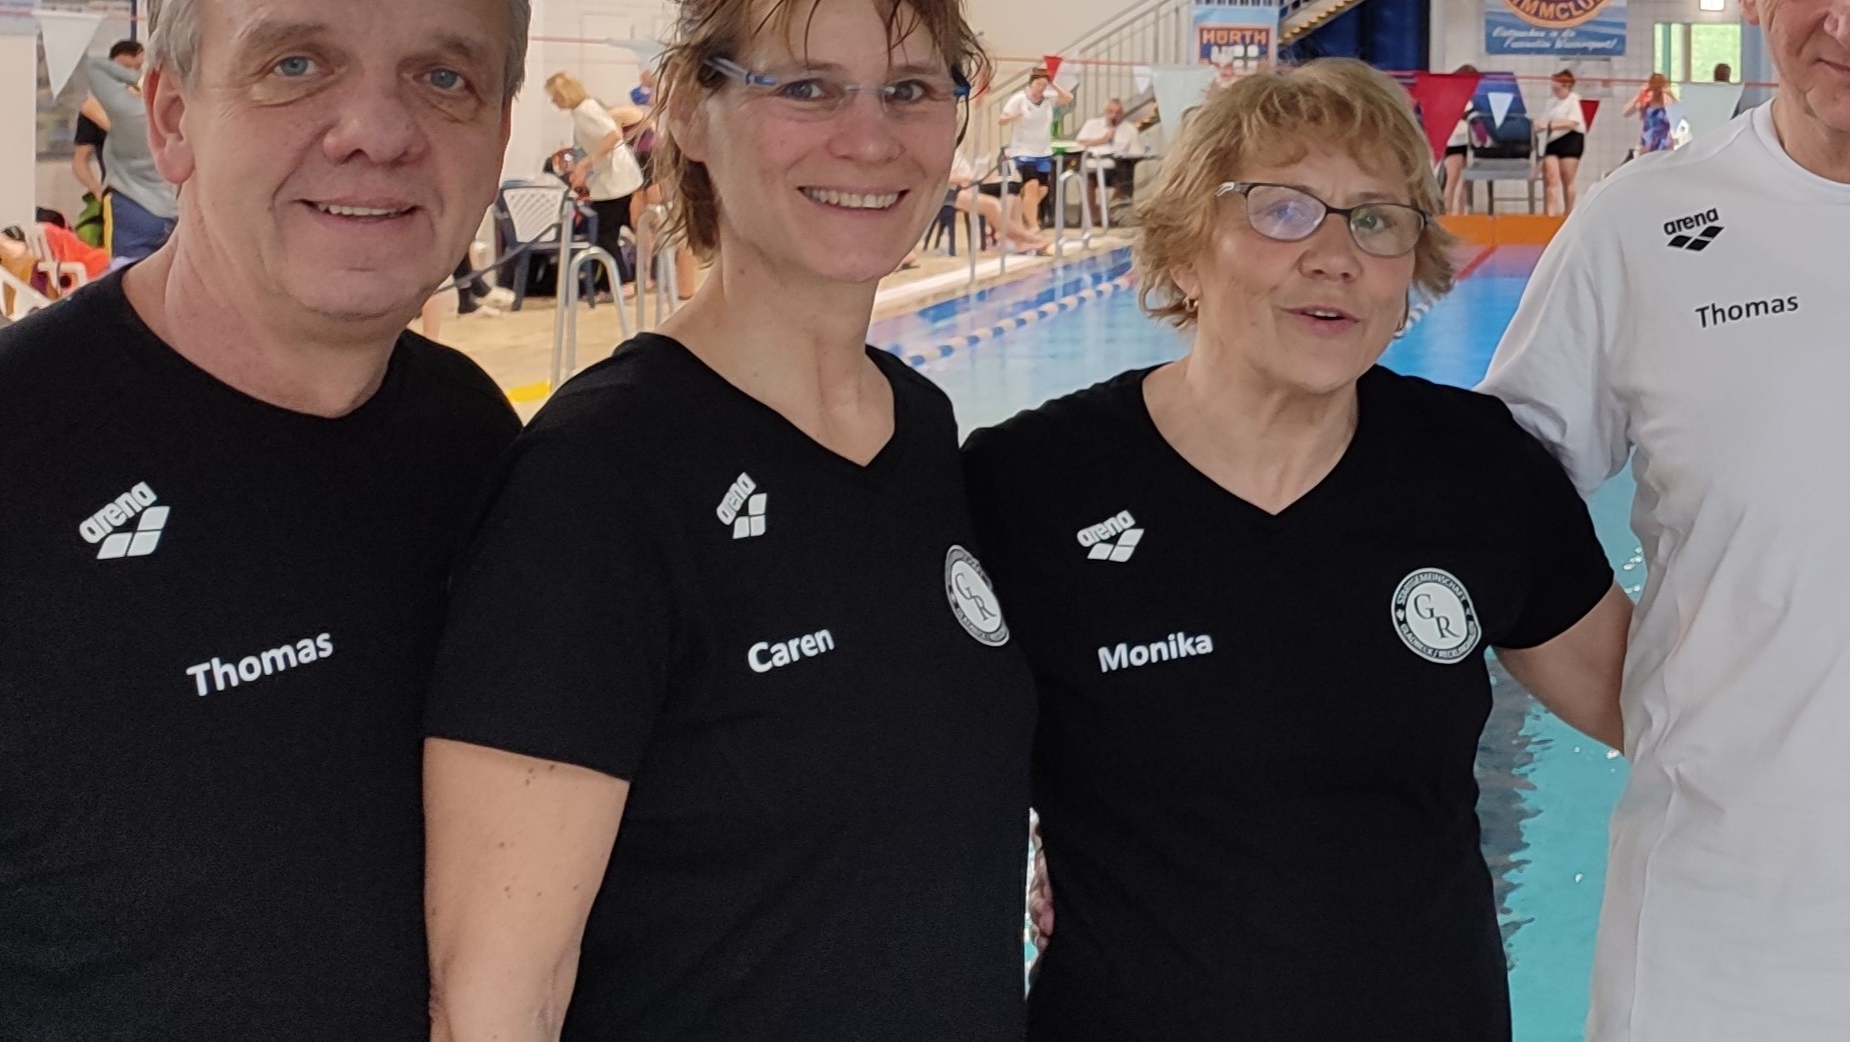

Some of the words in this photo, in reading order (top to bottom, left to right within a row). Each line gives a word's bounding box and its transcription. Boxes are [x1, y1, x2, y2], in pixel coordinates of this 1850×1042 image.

[1663, 207, 1720, 236] arena
[1695, 295, 1799, 329] Thomas
[79, 481, 157, 544] arena
[1077, 510, 1136, 548] arena
[186, 633, 333, 696] Thomas
[747, 629, 835, 673] Caren
[1098, 631, 1214, 673] Monika
